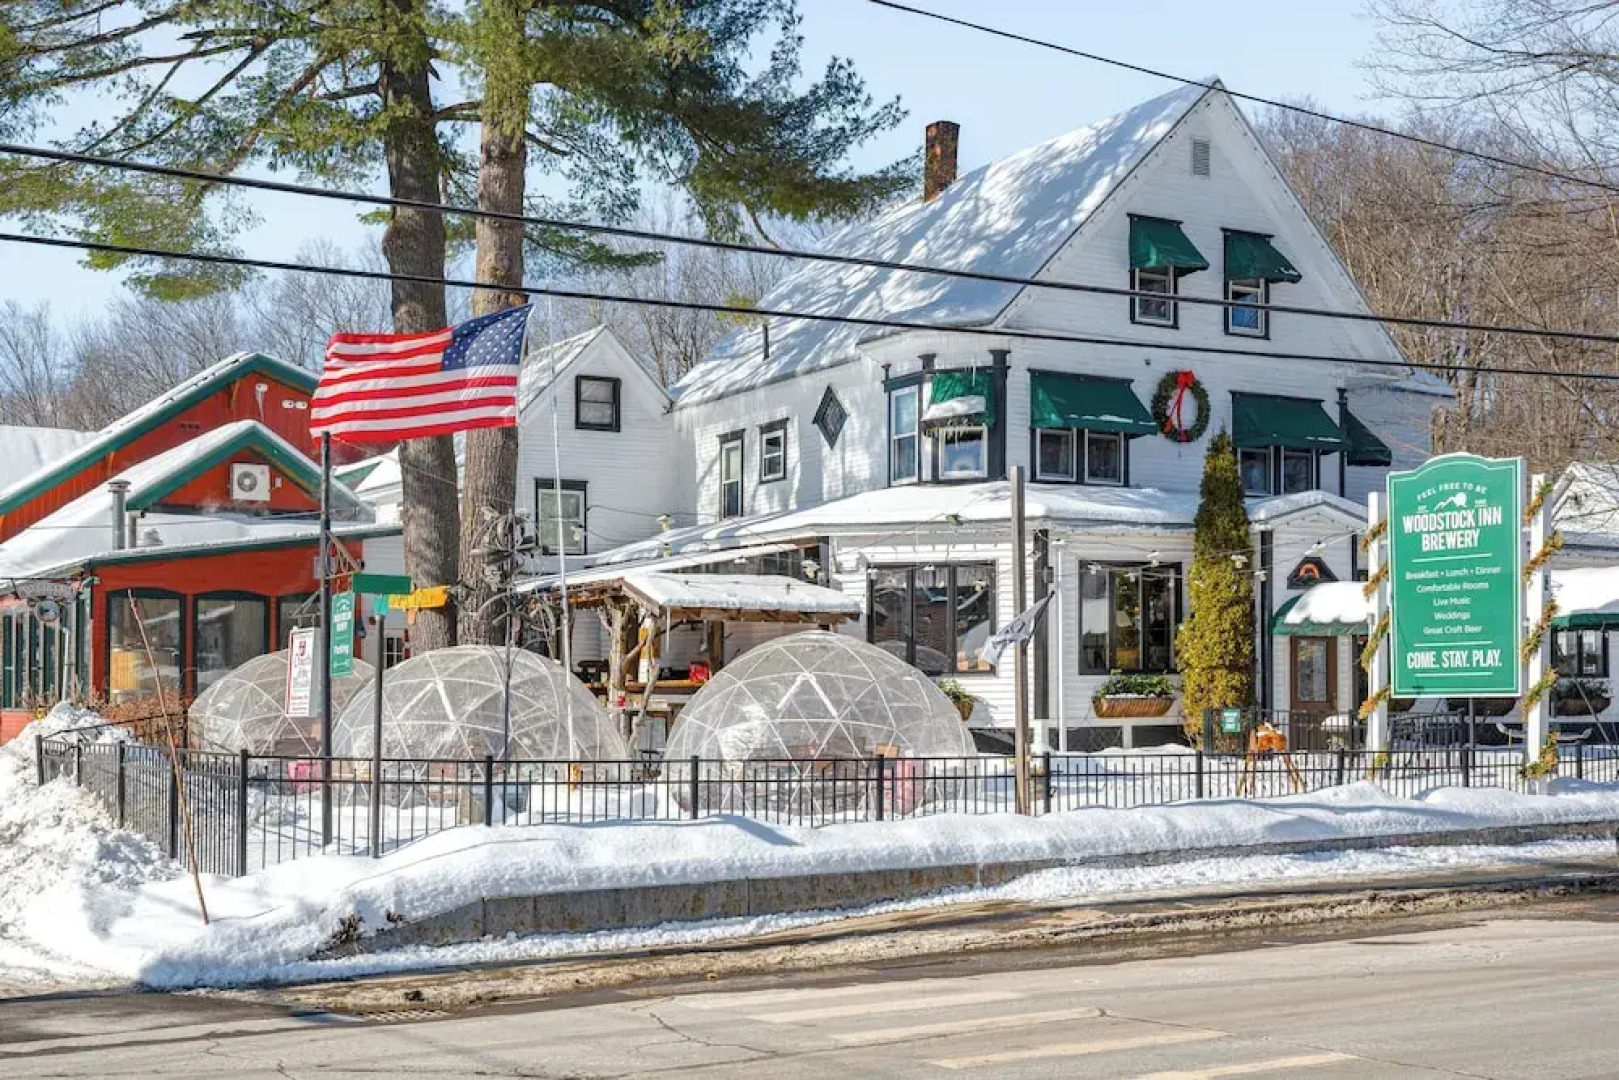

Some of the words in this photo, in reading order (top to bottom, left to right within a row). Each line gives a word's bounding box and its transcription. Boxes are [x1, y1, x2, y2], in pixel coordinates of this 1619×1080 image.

[1417, 487, 1436, 500] FEEL
[1439, 482, 1460, 490] FREE
[1463, 482, 1473, 490] TO
[1475, 485, 1488, 494] BE
[1402, 509, 1475, 533] WOODSTOCK
[1479, 505, 1501, 526] INN
[1422, 528, 1480, 551] BREWERY
[1405, 569, 1439, 580] Breakfast
[1445, 567, 1469, 577] Lunch
[1475, 566, 1501, 575] Dinner
[1416, 582, 1461, 593] Comfortable
[1462, 581, 1489, 590] Rooms
[1433, 598, 1448, 606] Live
[1449, 597, 1471, 605] Music
[1434, 611, 1470, 620] Weddings
[1423, 626, 1443, 635] Great
[1444, 625, 1463, 634] Craft
[1465, 624, 1482, 633] Beer
[1407, 650, 1439, 669] COME.
[1441, 649, 1470, 668] STAY.
[1472, 648, 1502, 667] PLAY.
